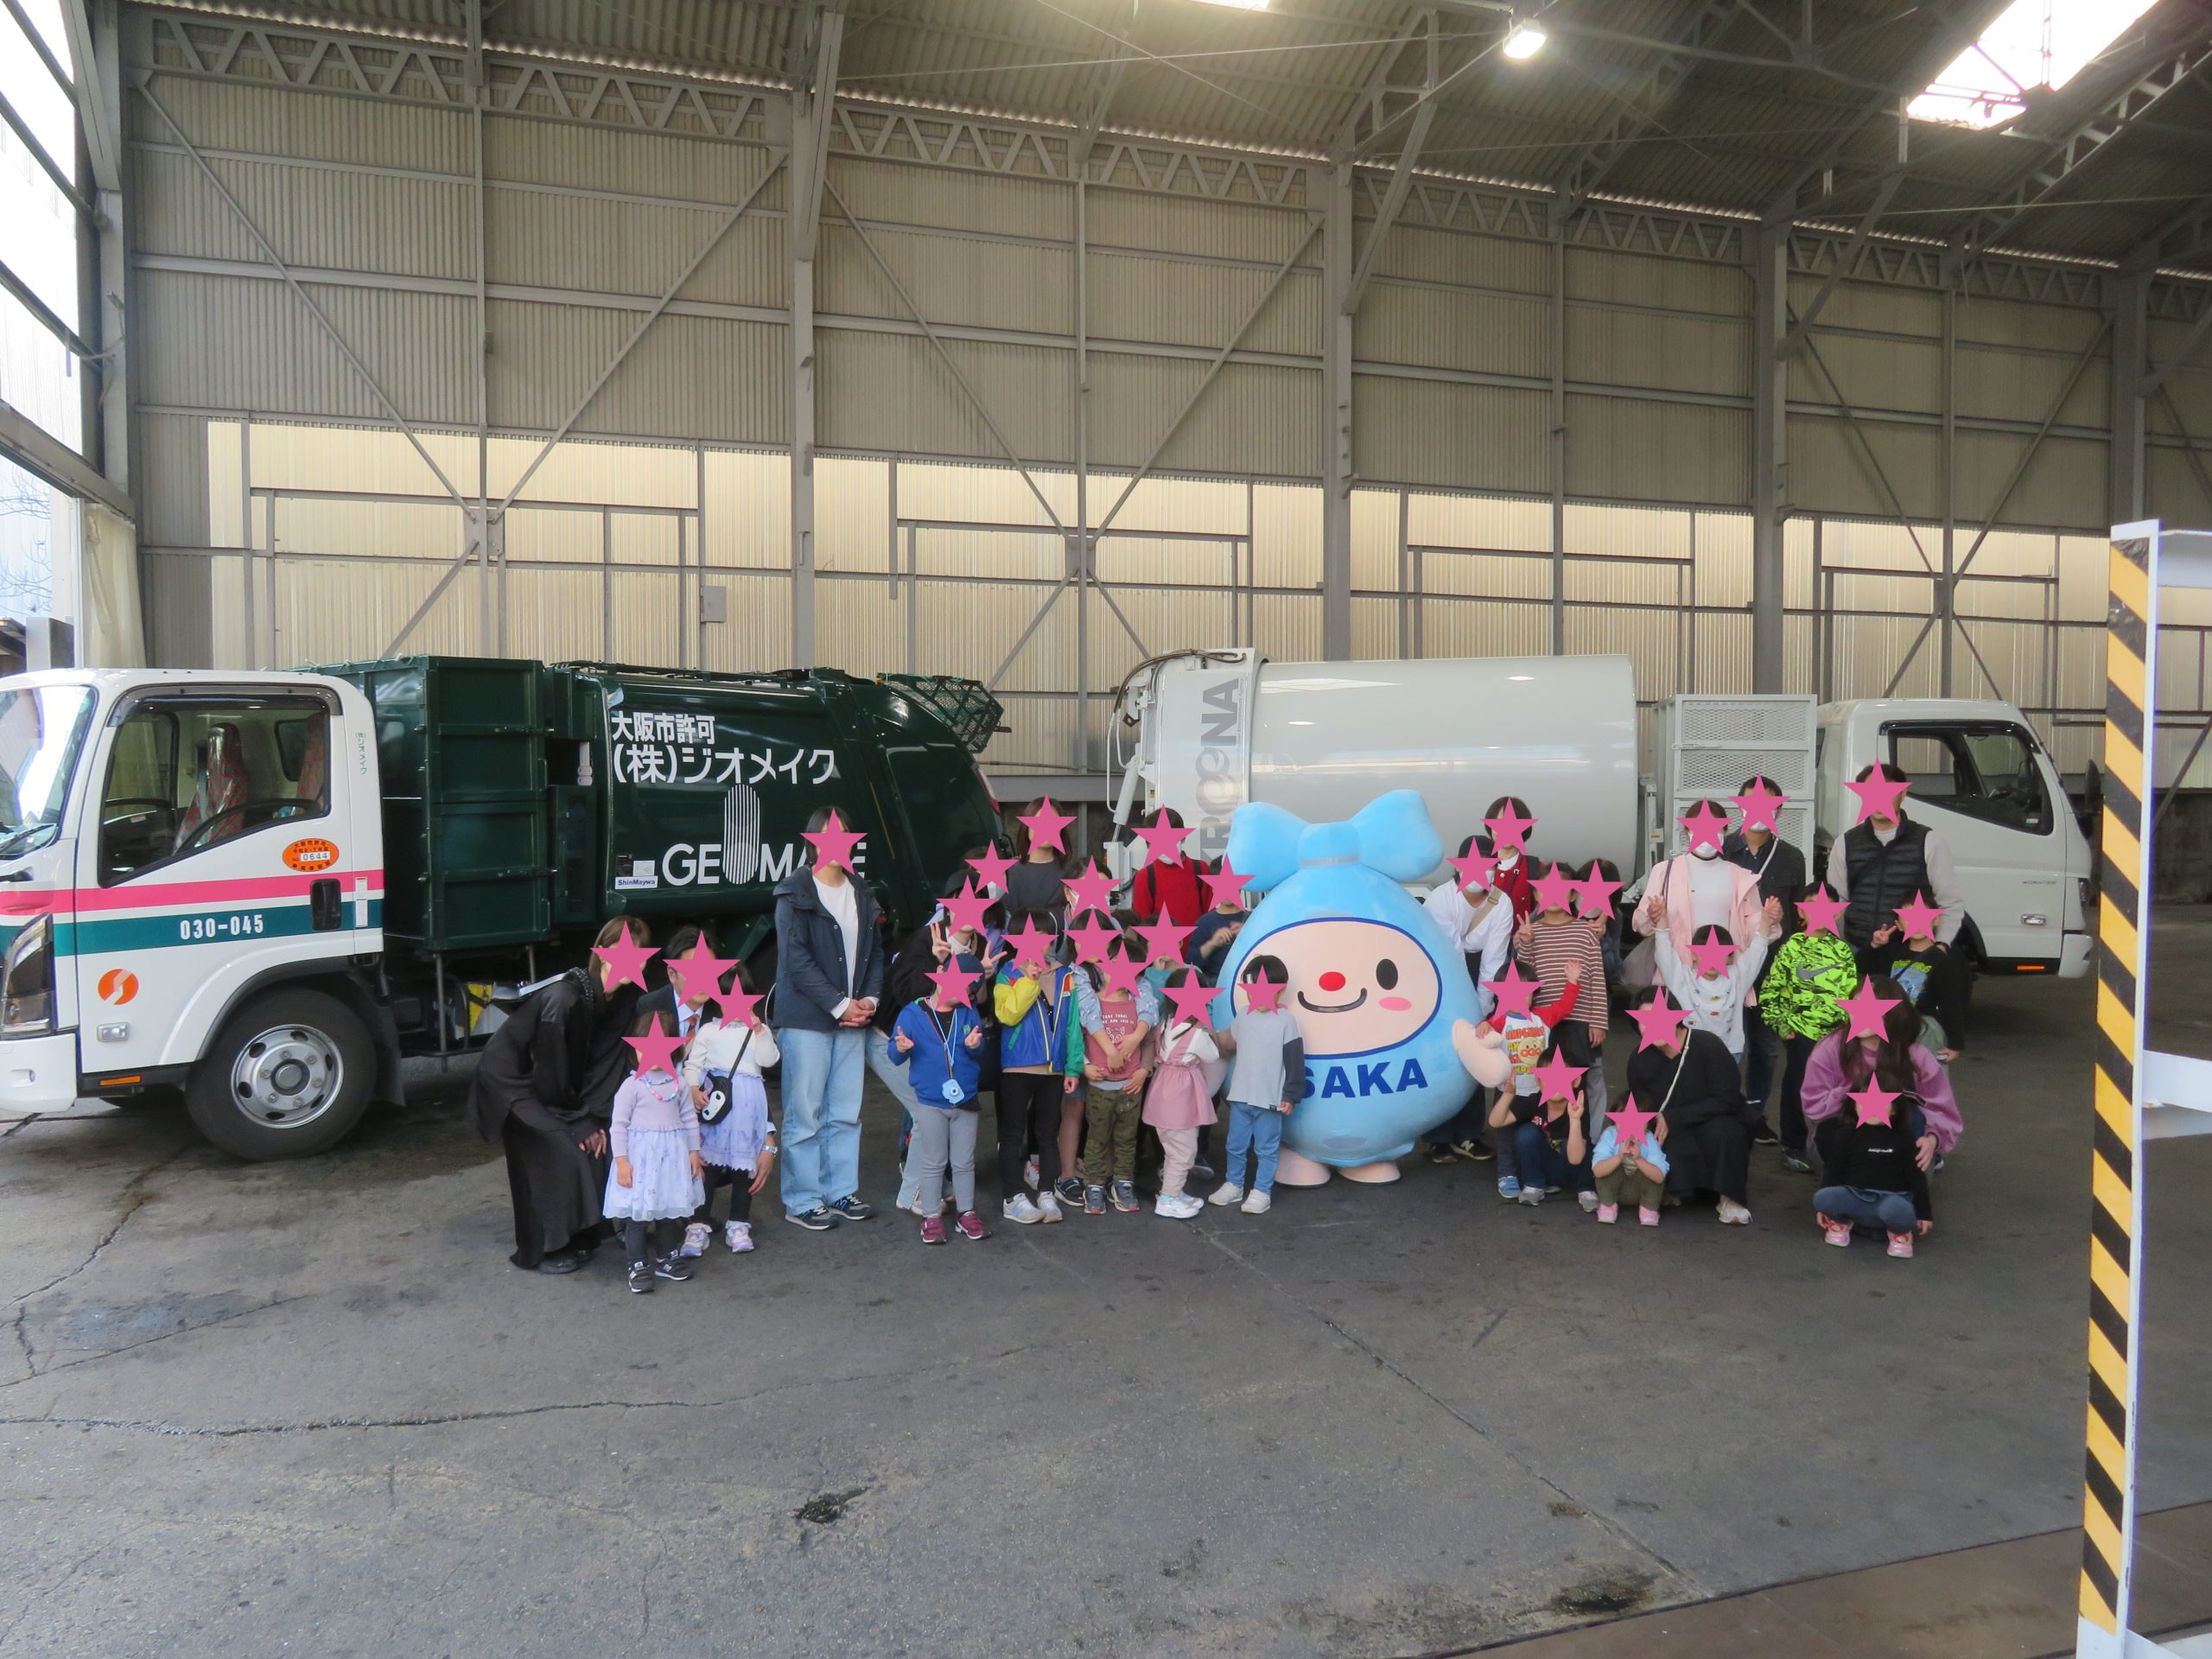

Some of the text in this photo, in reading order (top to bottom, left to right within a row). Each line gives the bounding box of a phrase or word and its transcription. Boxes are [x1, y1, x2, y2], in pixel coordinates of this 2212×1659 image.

[611, 711, 715, 744] 大阪市許可
[613, 743, 835, 785] (株)ジオメイク
[302, 852, 328, 861] 0644
[179, 913, 264, 941] 030-045
